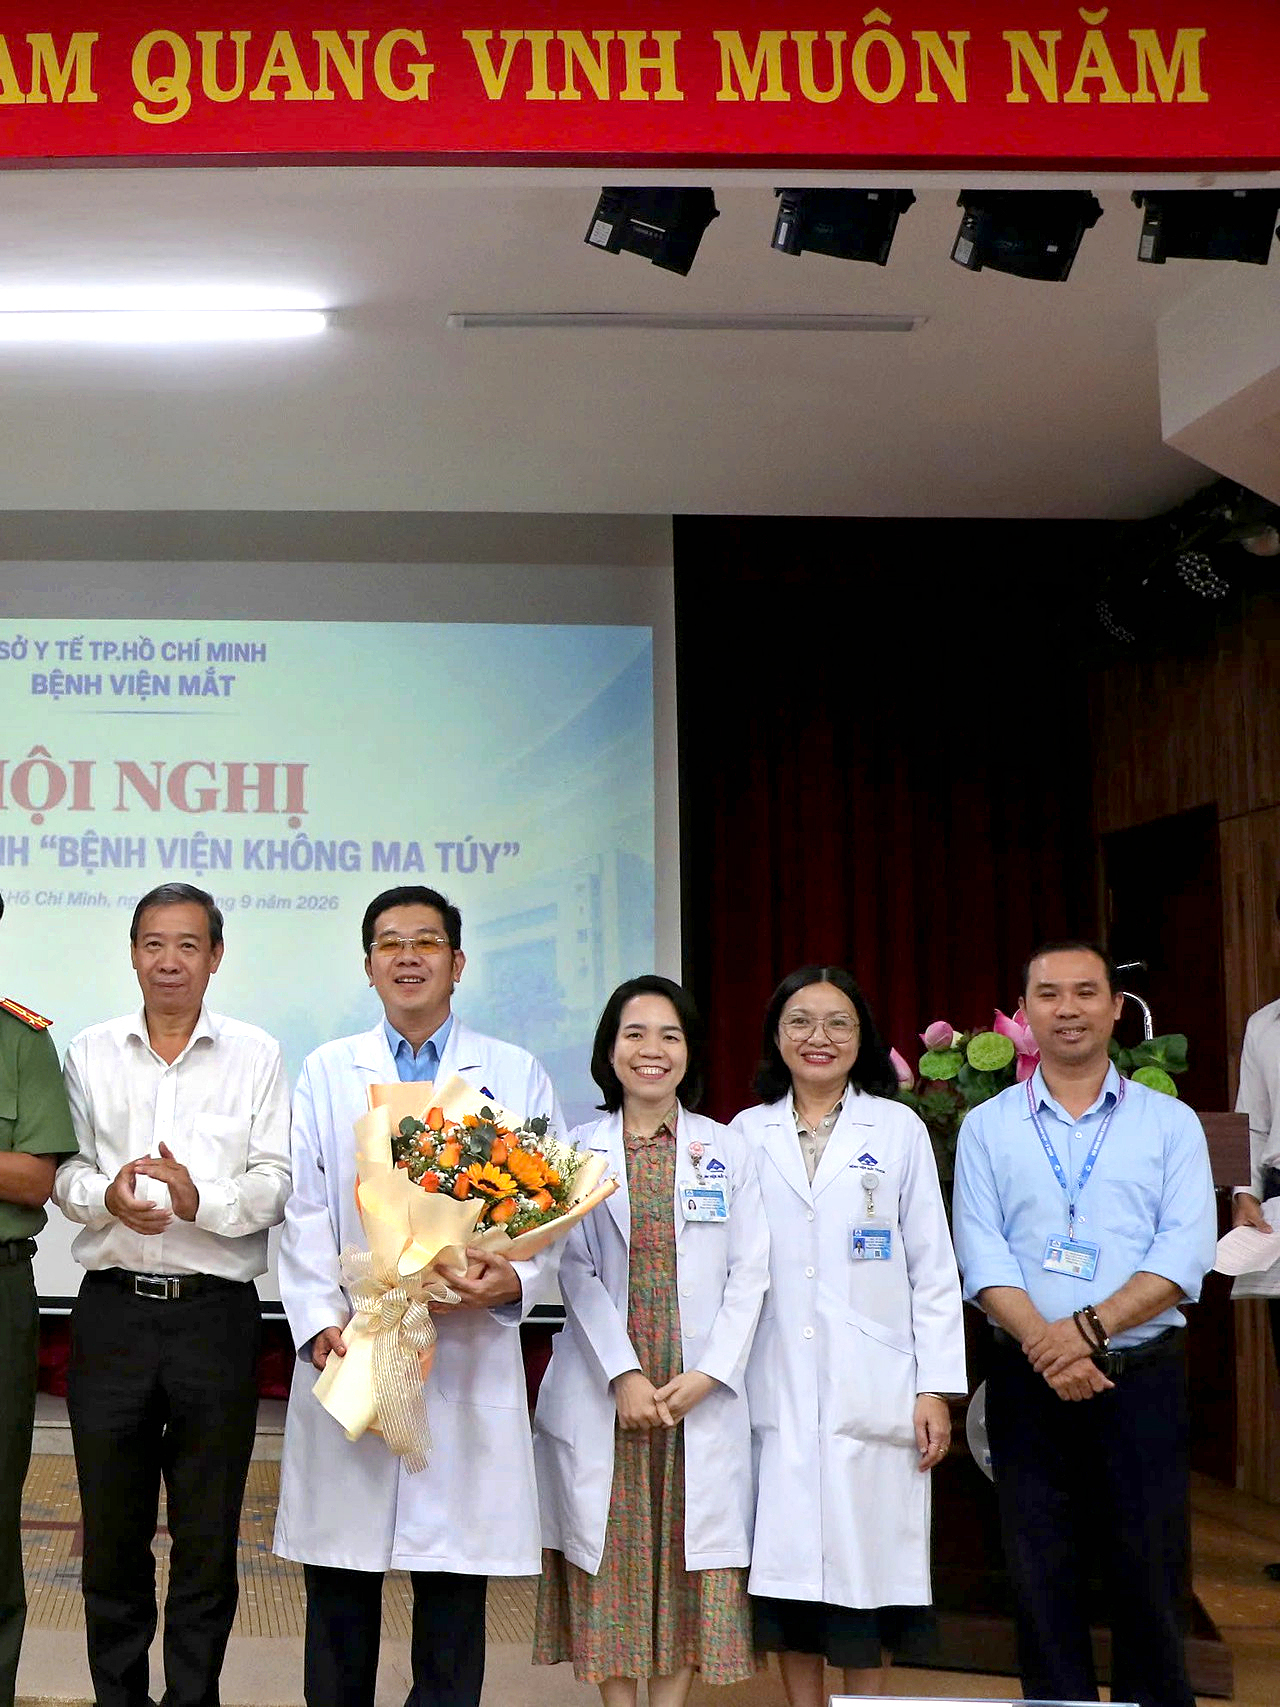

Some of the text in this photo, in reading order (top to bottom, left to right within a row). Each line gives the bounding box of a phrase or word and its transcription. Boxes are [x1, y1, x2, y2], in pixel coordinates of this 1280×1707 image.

[131, 29, 435, 125] QUANG
[462, 29, 684, 101] VINH
[714, 8, 969, 104] MUÔN
[1004, 8, 1209, 104] NĂM
[34, 641, 49, 661] Y
[55, 635, 84, 661] TẾ
[89, 635, 155, 662] TP.HỒ
[161, 637, 200, 662] CHÍ
[207, 641, 267, 663] MINH
[31, 666, 237, 702] BỆNH VIỆN MẮT
[112, 760, 310, 830] NGHỊ
[156, 831, 233, 876] VIỆN
[243, 833, 361, 872] KHÔNG
[372, 841, 425, 872] MA
[240, 894, 252, 909] 9
